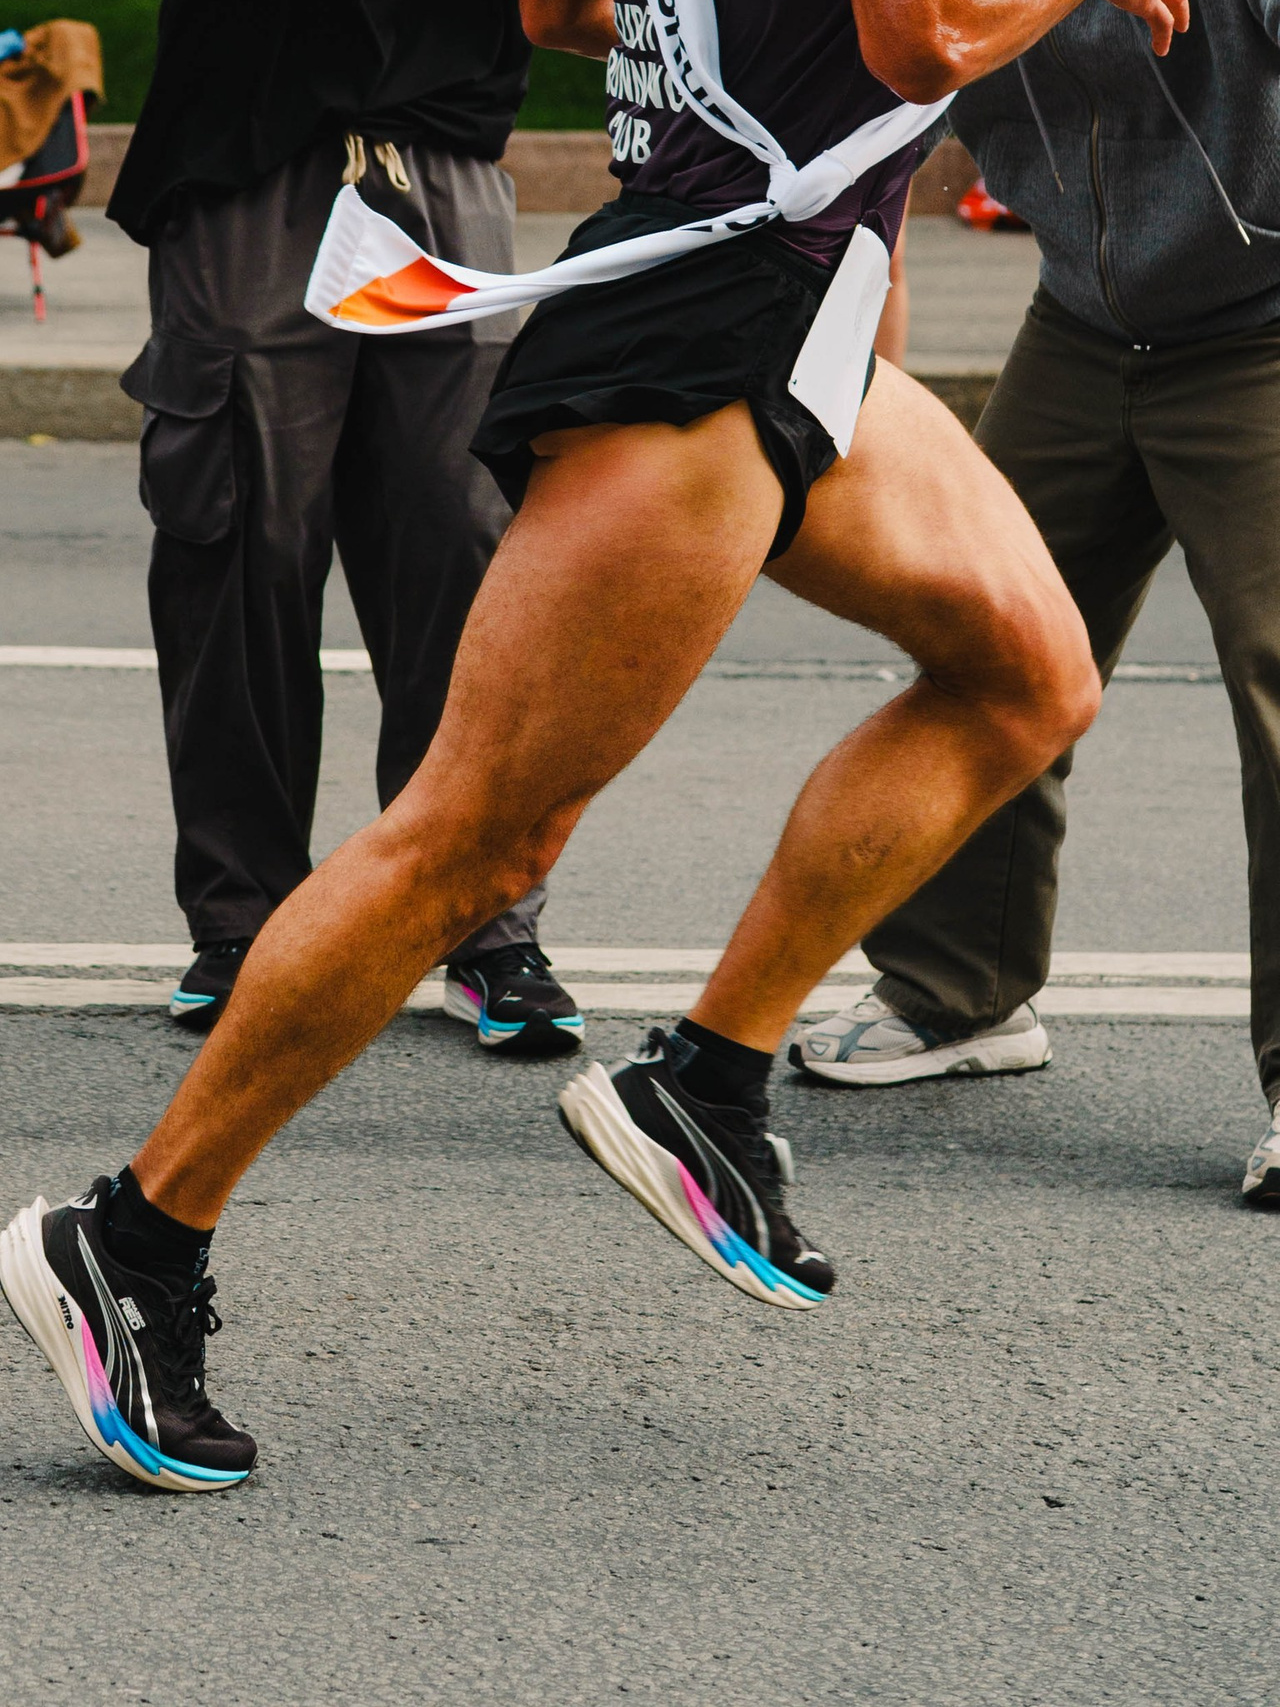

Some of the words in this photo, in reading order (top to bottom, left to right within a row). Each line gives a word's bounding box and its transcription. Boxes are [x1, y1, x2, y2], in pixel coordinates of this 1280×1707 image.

[608, 110, 652, 164] CLUB
[58, 1293, 75, 1331] NITRO
[118, 1296, 141, 1331] RED
